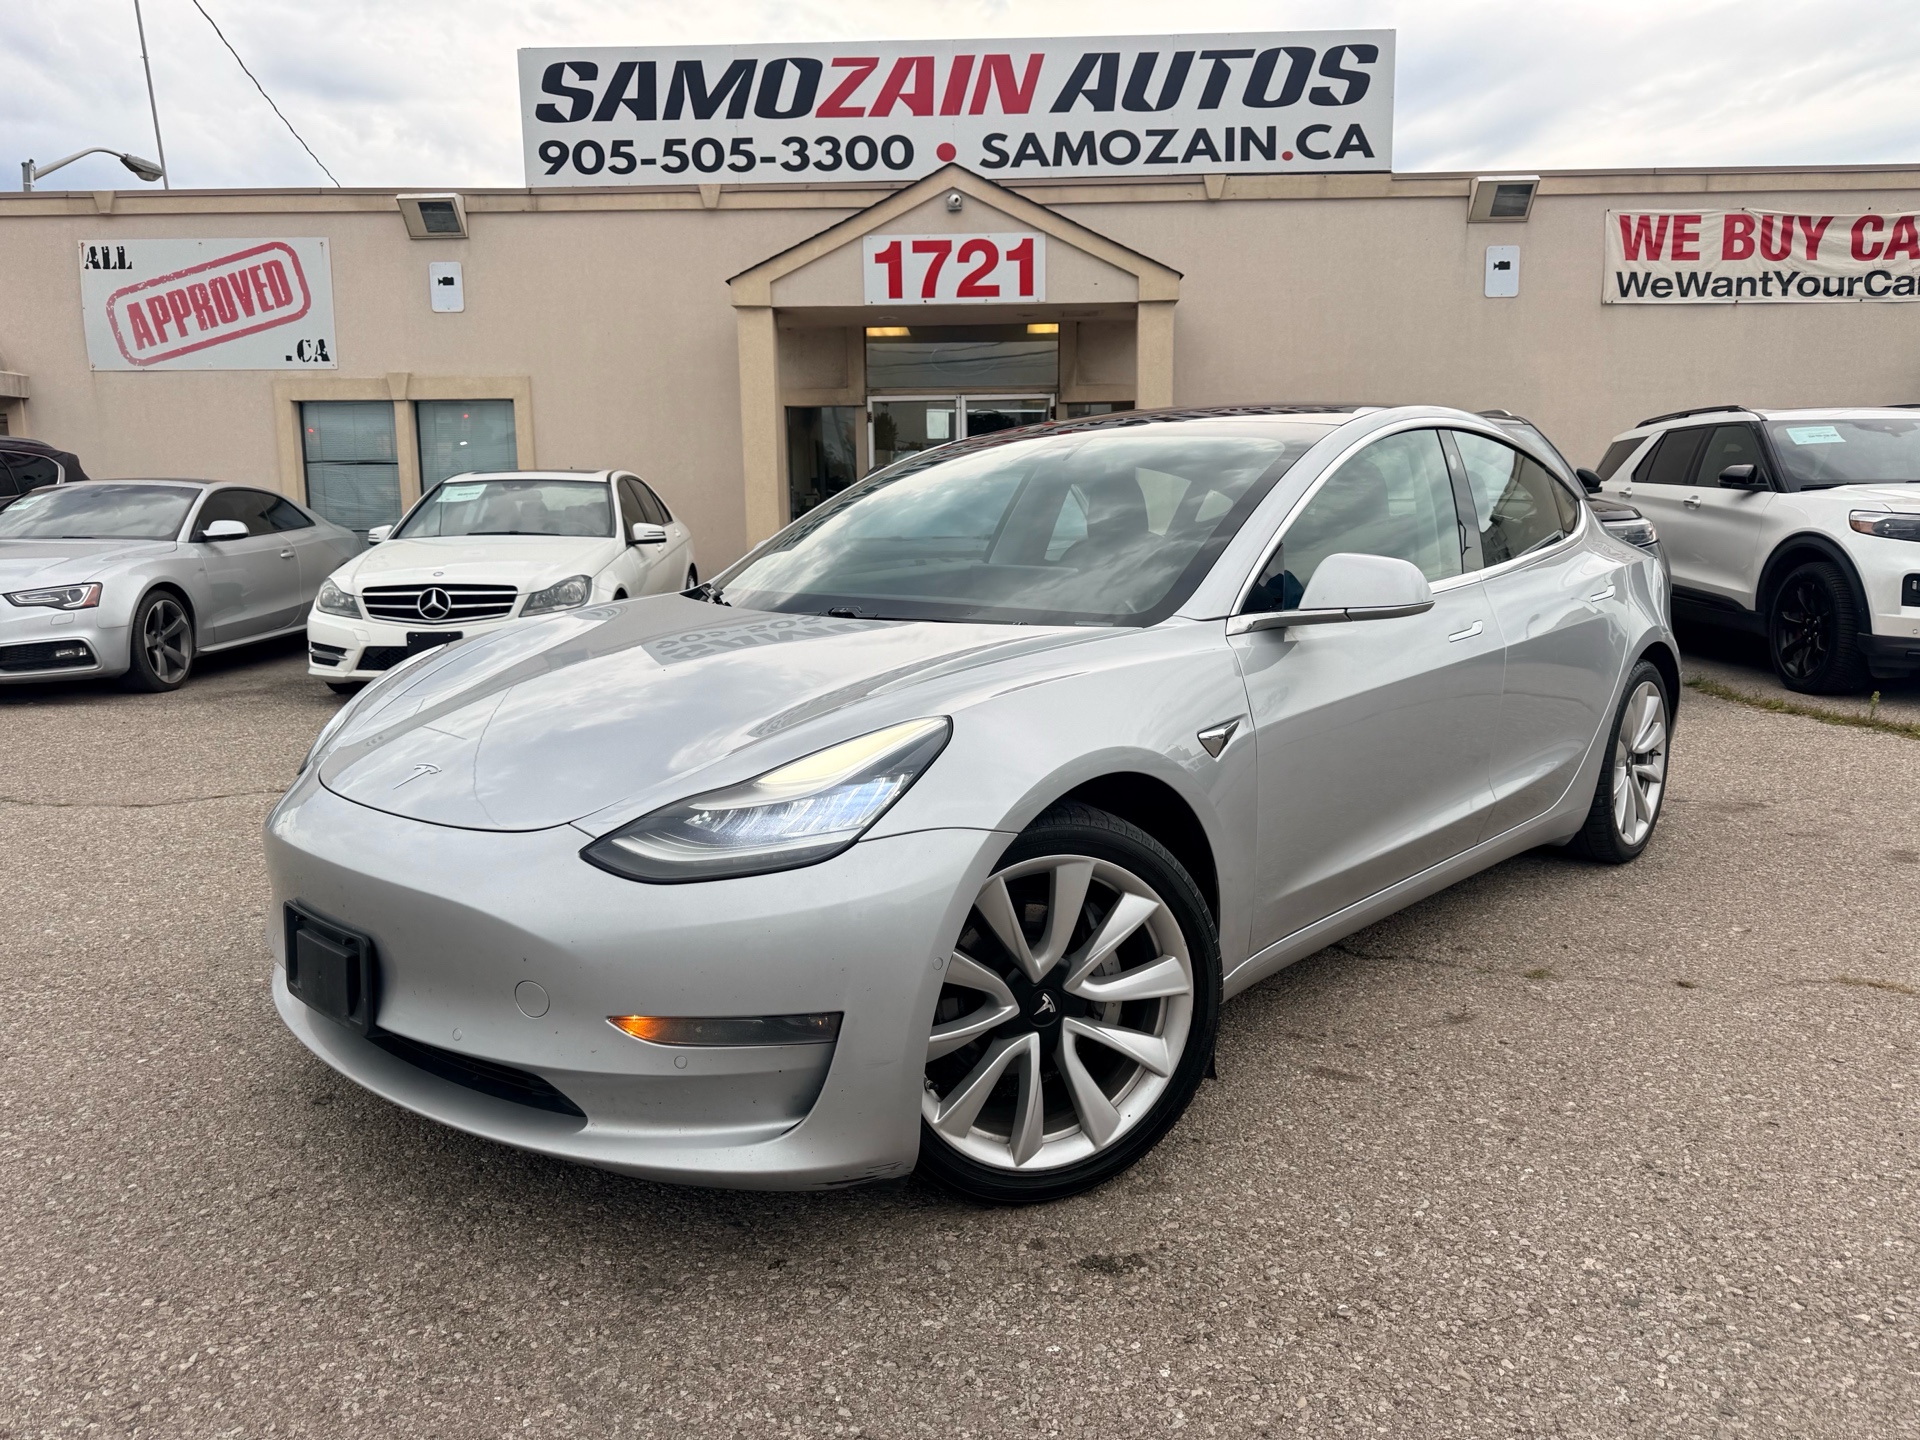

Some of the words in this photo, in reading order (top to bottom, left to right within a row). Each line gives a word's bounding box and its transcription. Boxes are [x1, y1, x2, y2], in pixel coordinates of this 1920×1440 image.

[535, 53, 1044, 123] SAMOZAIN
[1050, 44, 1380, 114] AUTOS
[538, 134, 915, 176] 905-505-3300
[980, 123, 1376, 170] SAMOZAIN.CA
[84, 245, 134, 271] ALL
[1619, 214, 1703, 261] WE
[1721, 213, 1834, 262] BUY
[874, 238, 1035, 300] 1721
[1616, 269, 1920, 298] WeWantYourCa
[127, 258, 294, 352] APPROVED
